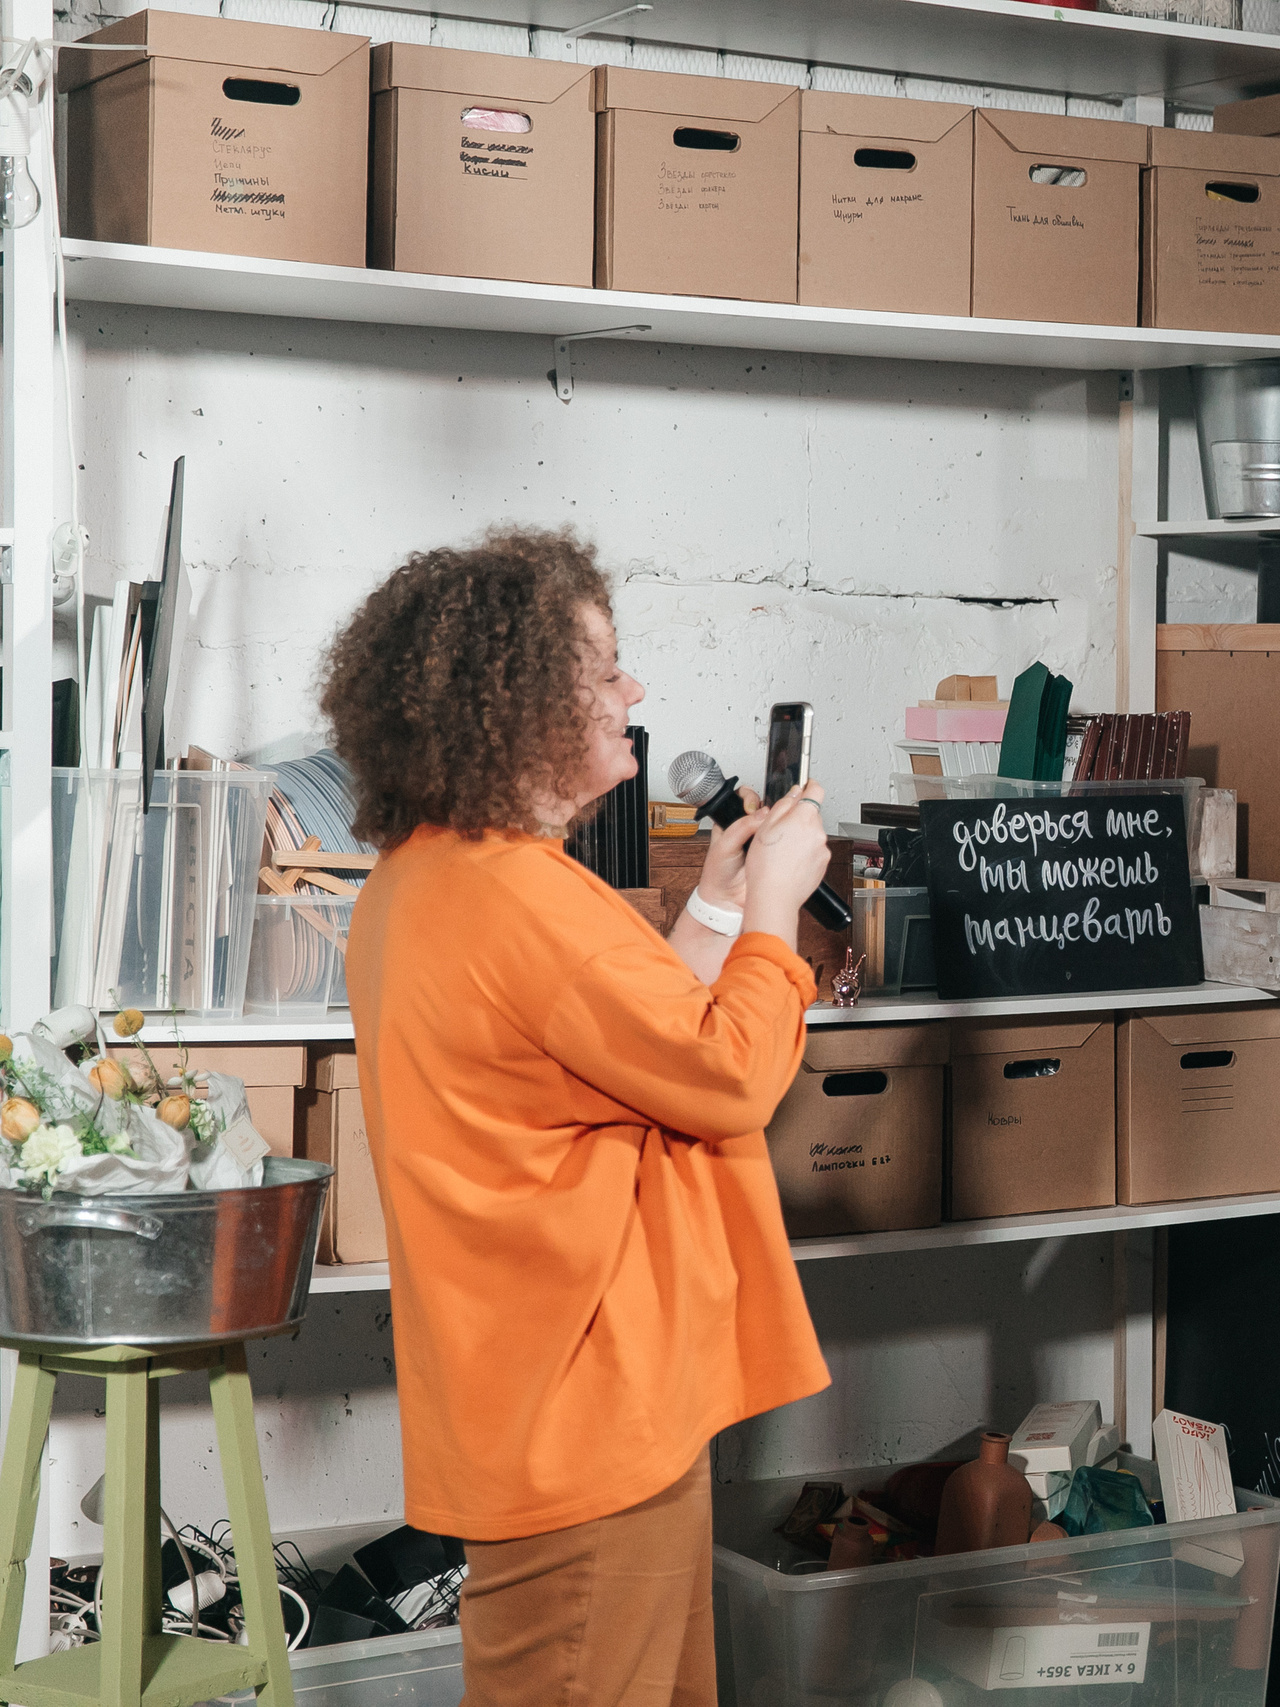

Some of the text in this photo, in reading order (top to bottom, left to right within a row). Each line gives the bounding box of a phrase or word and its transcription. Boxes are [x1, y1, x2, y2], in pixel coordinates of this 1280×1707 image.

[953, 802, 1173, 872] доверься мне,
[979, 851, 1159, 893] ты можешь
[964, 896, 1172, 956] танцевать
[1172, 1415, 1217, 1435] LOVELY
[1181, 1426, 1210, 1441] DAY!
[1036, 1662, 1136, 1678] 6 x IKEA 365+
